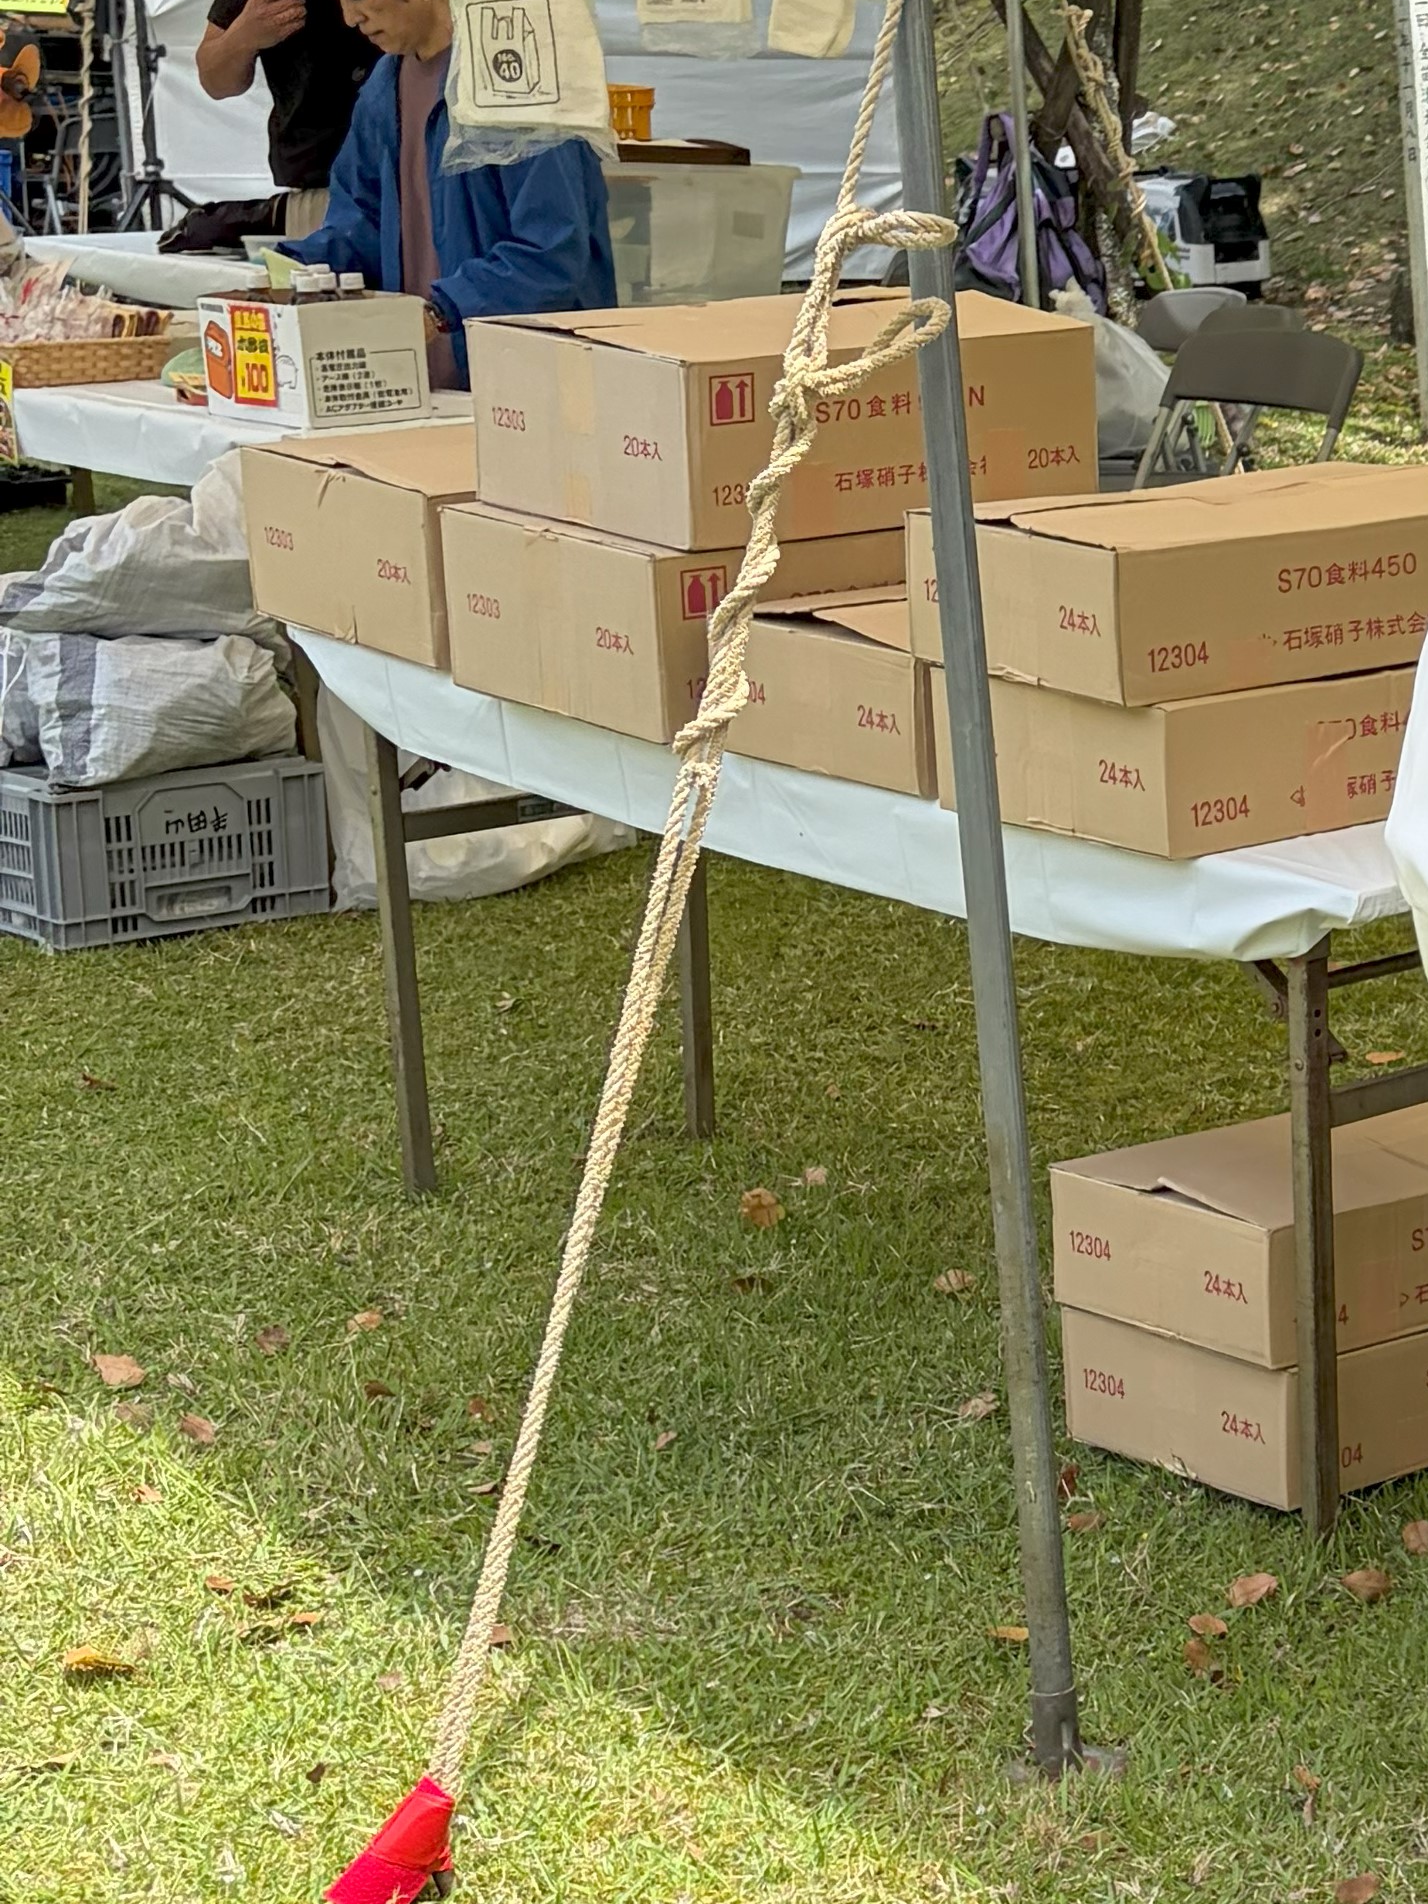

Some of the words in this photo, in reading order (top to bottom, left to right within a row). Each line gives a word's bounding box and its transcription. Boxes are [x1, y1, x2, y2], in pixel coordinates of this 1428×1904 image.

[491, 406, 527, 432] 12303
[623, 434, 664, 461] 20本入
[1027, 444, 1081, 470] 20本入
[264, 526, 295, 551] 12303
[377, 557, 412, 585] 20本入
[1277, 551, 1418, 594] S70食料450
[466, 592, 501, 620] 12303
[1058, 605, 1102, 637] 24本入
[595, 625, 635, 656] 20本入
[1146, 642, 1210, 673] 12304
[856, 704, 901, 736] 24本入
[1098, 759, 1146, 793] 24本入
[1189, 794, 1252, 828] 12304
[1069, 1229, 1112, 1261] 12304
[1203, 1270, 1249, 1304] 24本入
[1082, 1368, 1126, 1399] 12304
[1220, 1410, 1266, 1446] 24本入
